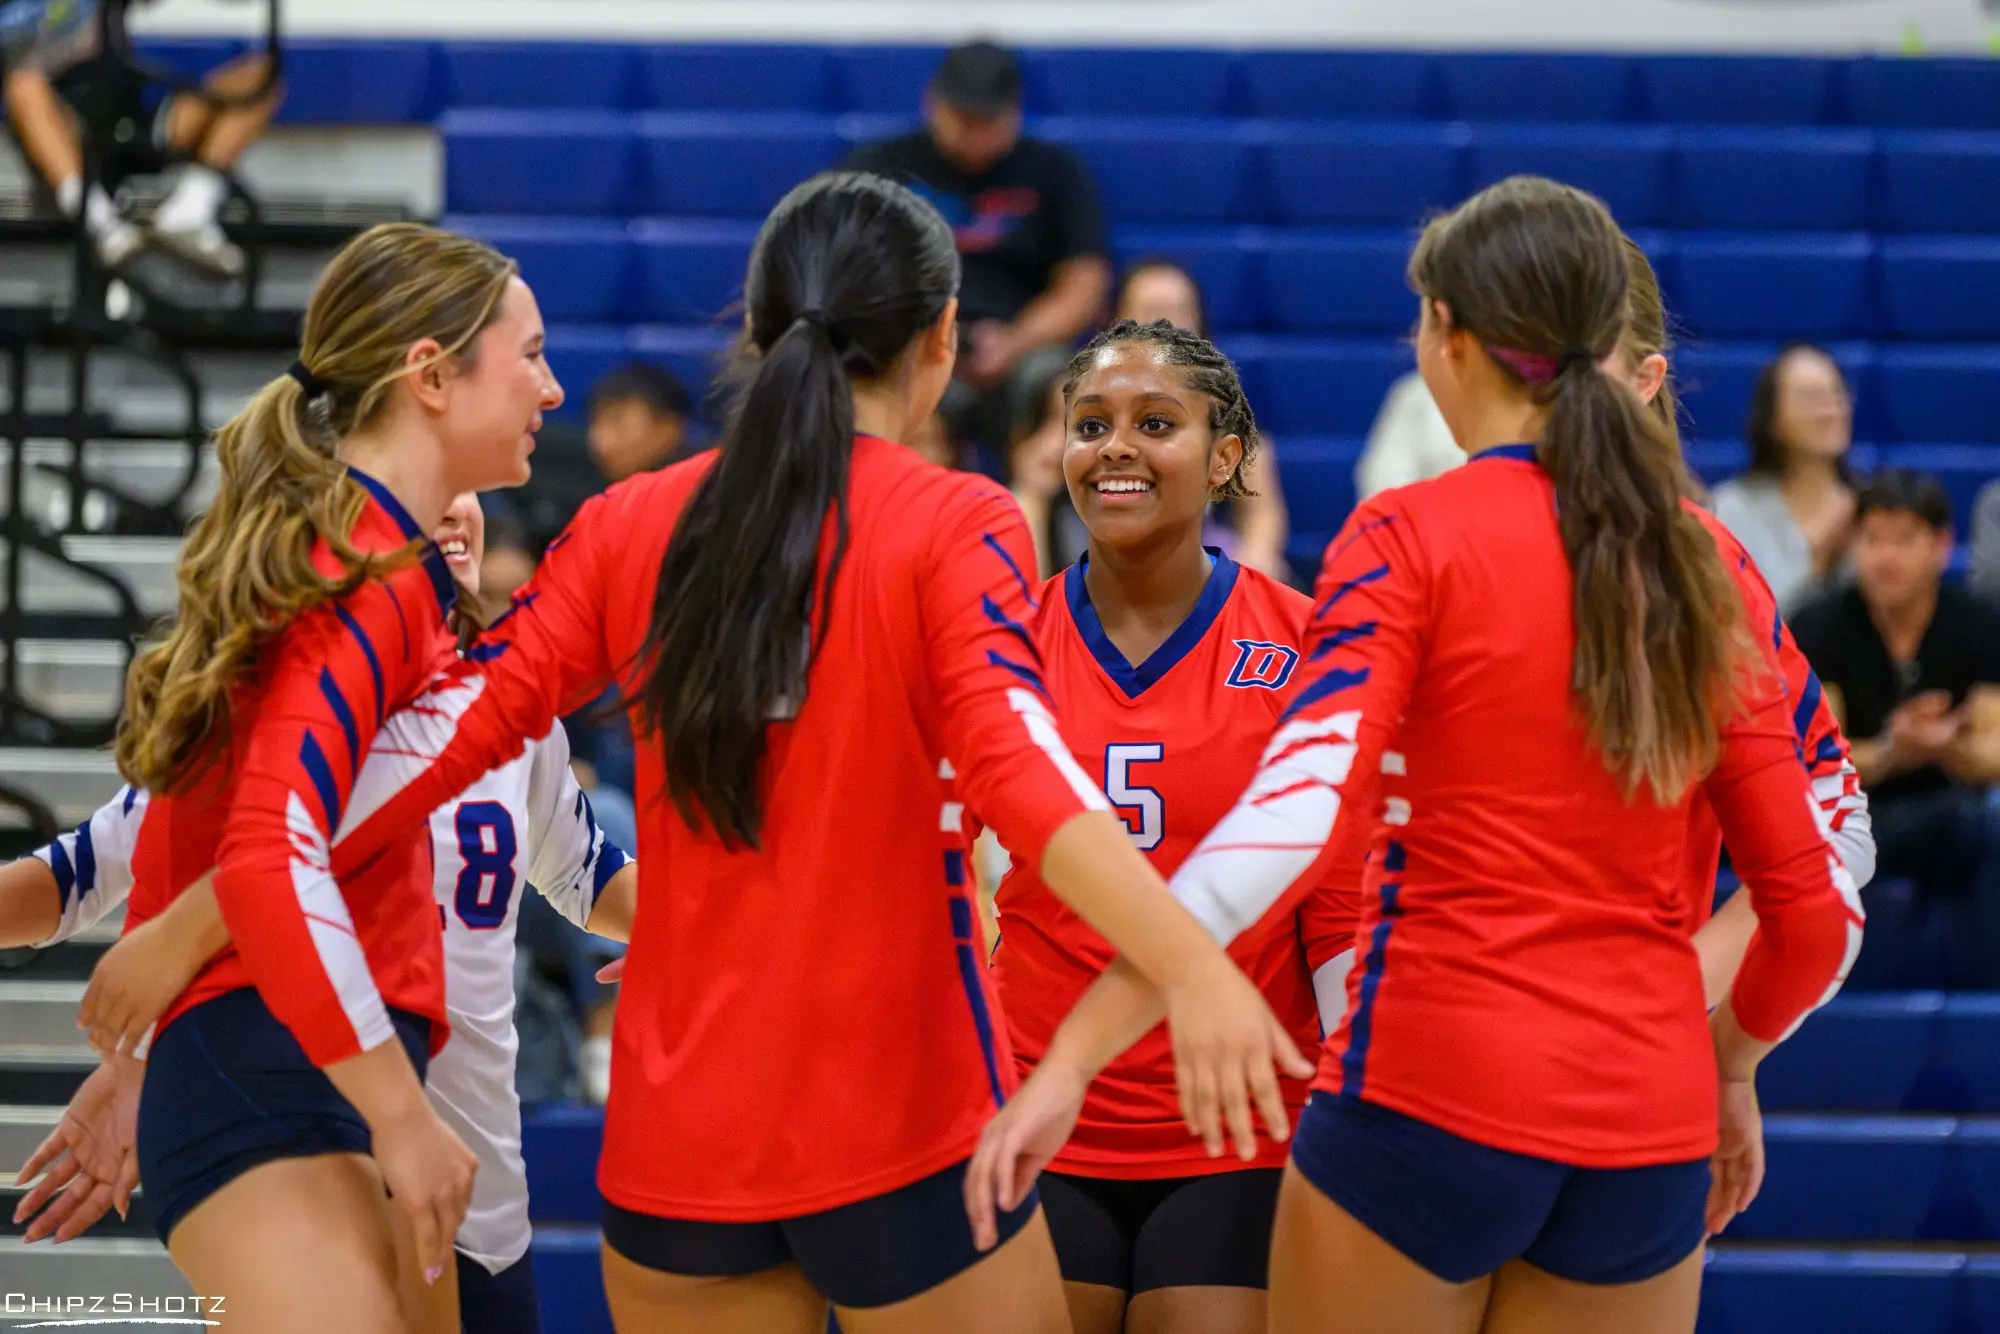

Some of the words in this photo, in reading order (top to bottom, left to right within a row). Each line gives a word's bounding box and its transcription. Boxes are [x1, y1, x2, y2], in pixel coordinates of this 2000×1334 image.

[1224, 639, 1300, 691] D
[1104, 742, 1166, 851] 5
[427, 800, 518, 932] 8
